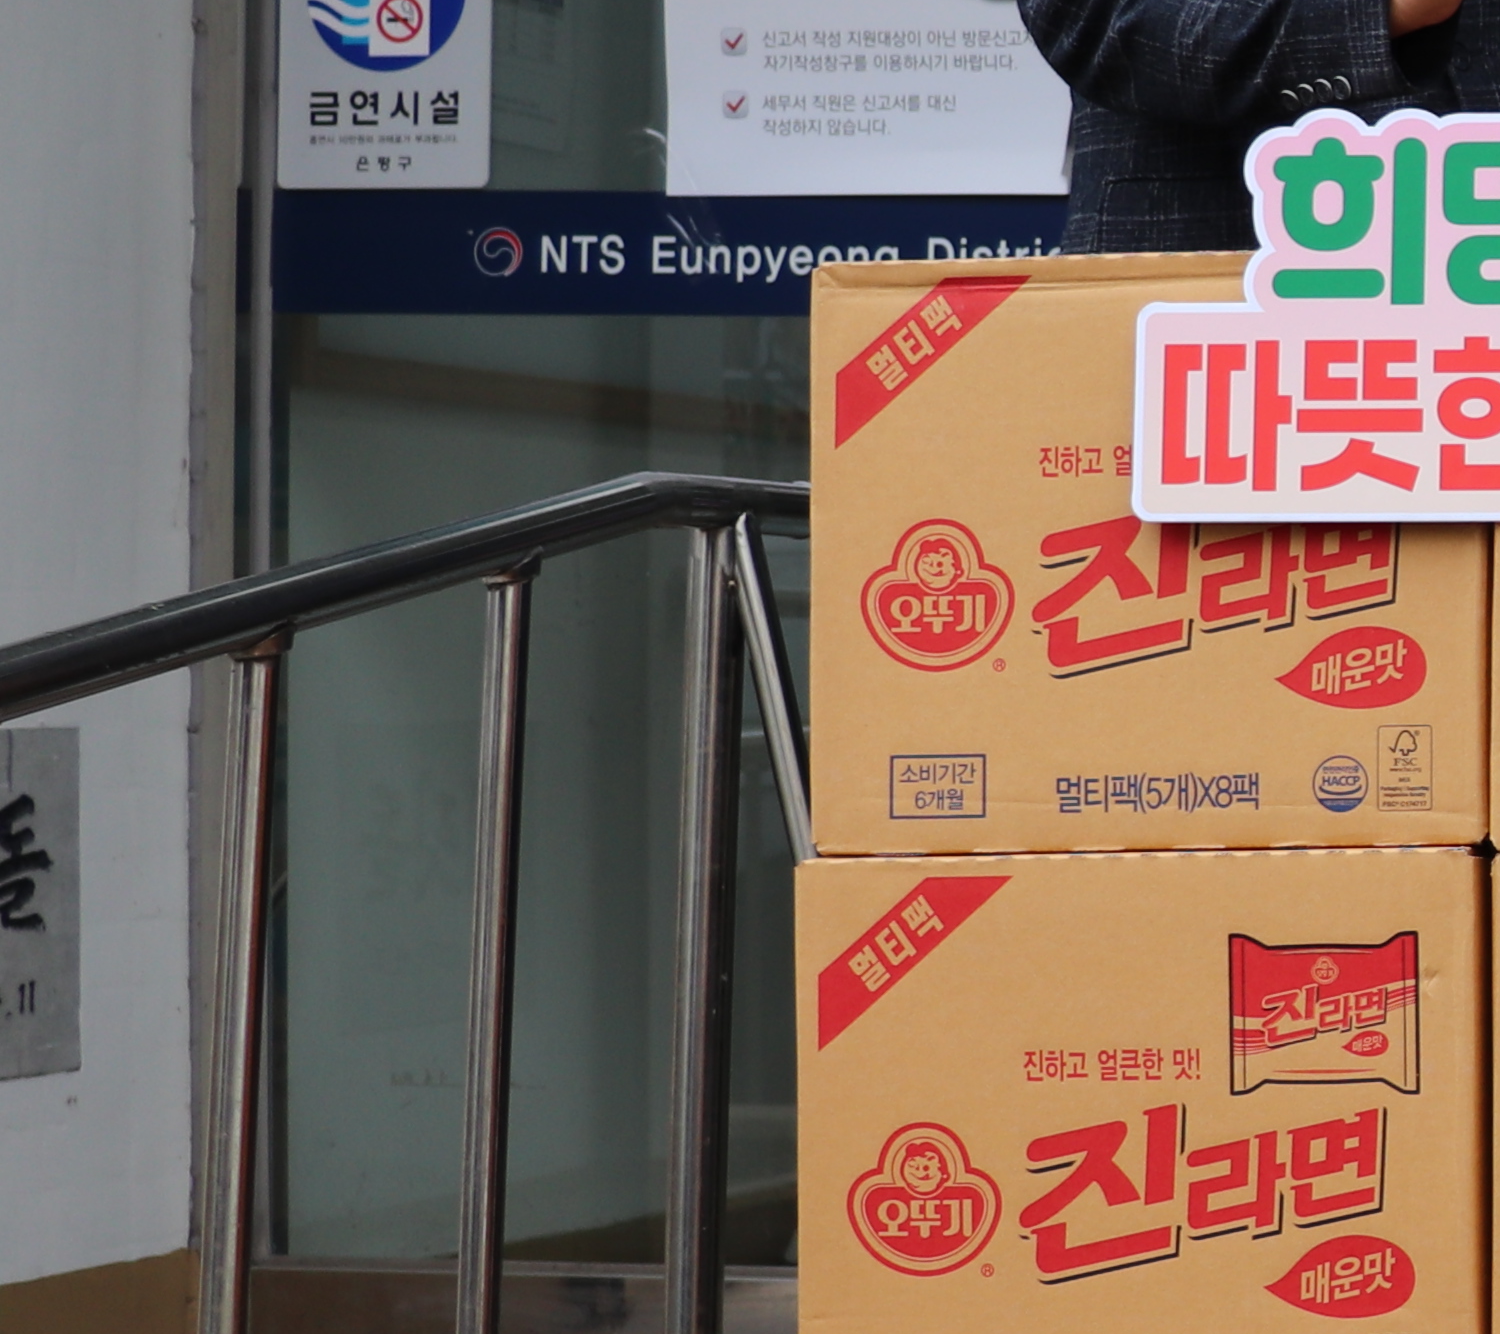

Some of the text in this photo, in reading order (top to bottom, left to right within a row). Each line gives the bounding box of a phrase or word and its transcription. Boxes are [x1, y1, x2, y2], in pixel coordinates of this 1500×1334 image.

[762, 30, 807, 48] 신고서
[812, 31, 841, 49] 작성
[848, 30, 921, 48] 지원대상이
[927, 30, 957, 48] 아닌
[763, 55, 1018, 72] 자기작성창구를 이용하시기 바랍니다.
[309, 90, 460, 126] 금연시설
[762, 95, 957, 112] 세무서 직원은 신고서를 대신
[762, 119, 891, 136] 작성하지 않습니다.
[356, 155, 412, 171] 은평구
[540, 234, 626, 275] NTS
[866, 296, 963, 390] 멀티팩
[1032, 517, 1401, 678] 진라면
[1311, 639, 1407, 695] 매운맛
[1055, 773, 1260, 814] 멀티팩(5개)X8팩
[1023, 1050, 1088, 1082] 진하고
[1097, 1049, 1164, 1081] 얼큰한
[1018, 1103, 1388, 1286] 진라면
[1300, 1248, 1395, 1305] 매운맛
